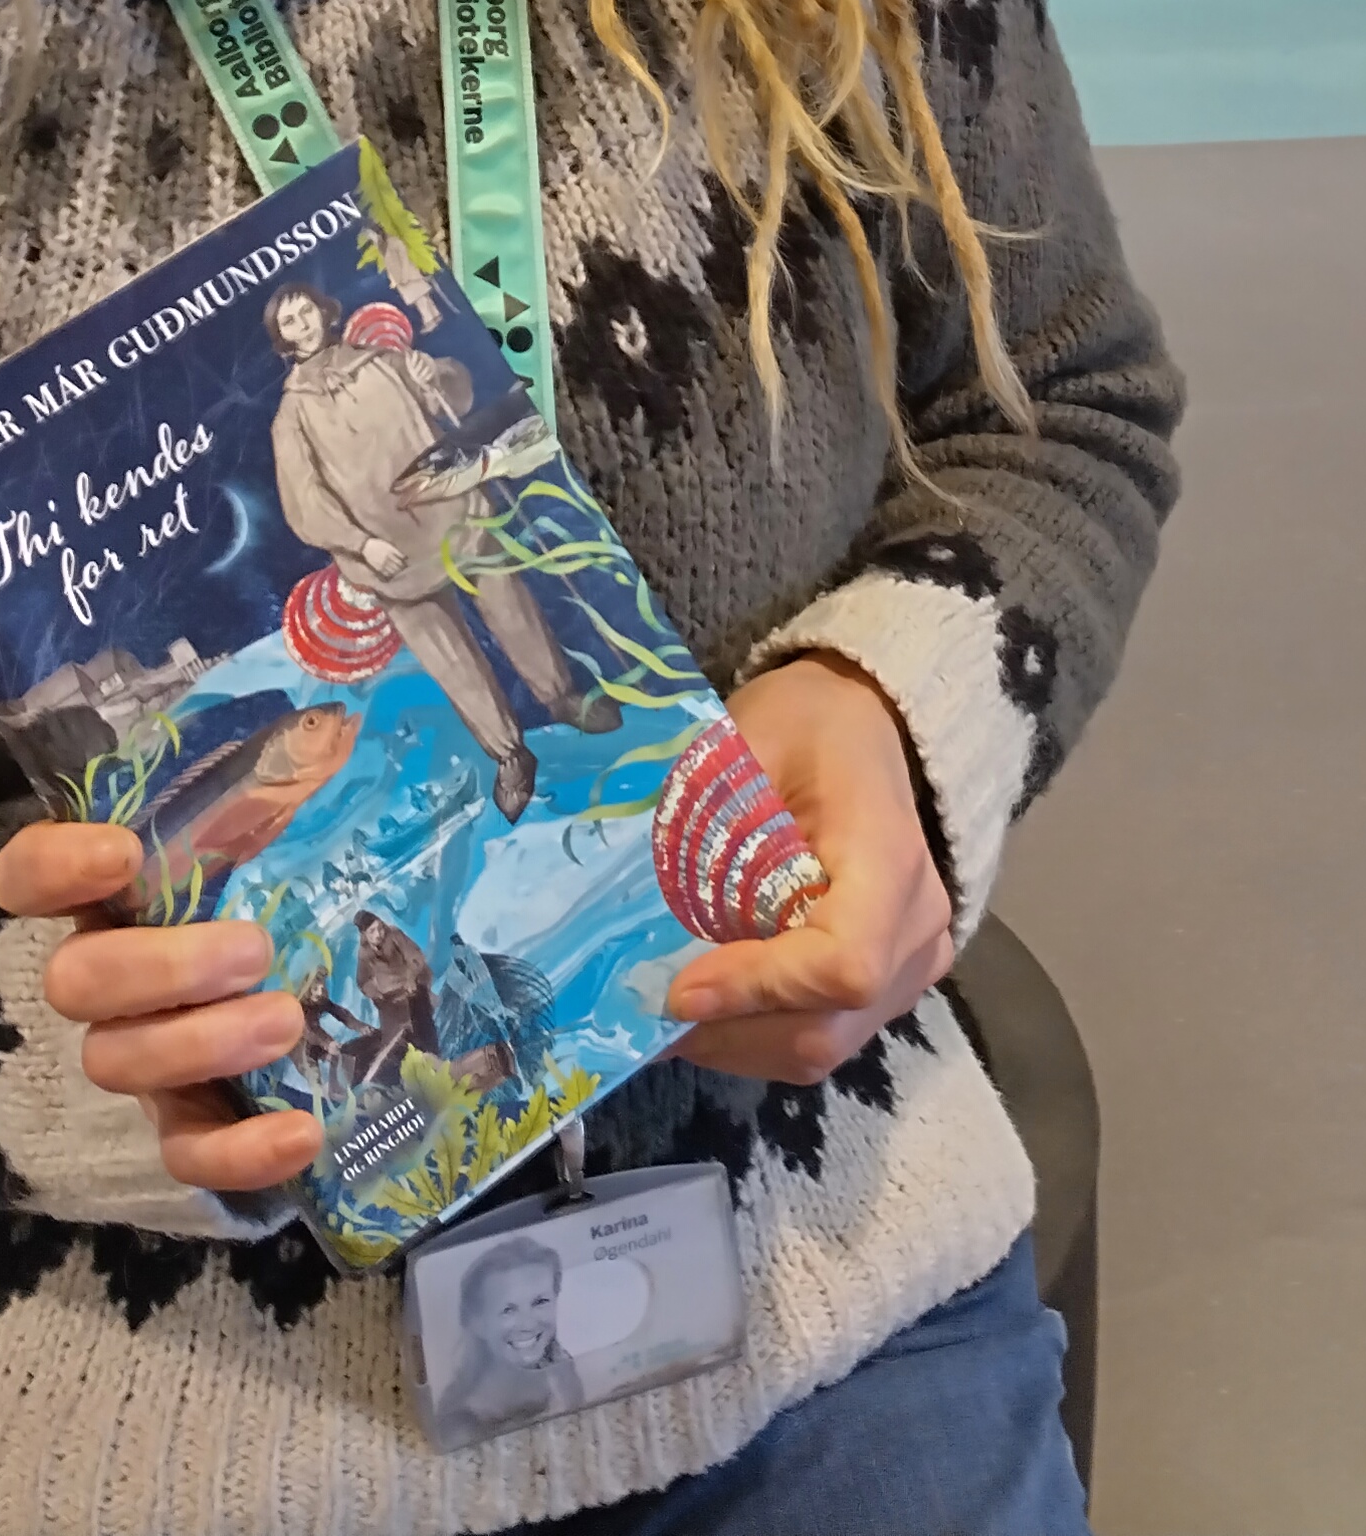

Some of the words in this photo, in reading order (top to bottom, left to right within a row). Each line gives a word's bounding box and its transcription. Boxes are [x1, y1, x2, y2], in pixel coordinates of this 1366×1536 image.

[22, 358, 107, 424] MÁR
[107, 192, 363, 370] GUÐMUNDSSON
[76, 422, 214, 526] kendes
[60, 548, 124, 626] for
[138, 482, 199, 557] ret
[333, 1096, 416, 1166] LINDHARDT
[342, 1159, 366, 1182] OG
[363, 1110, 427, 1166] RINGHOF
[589, 1213, 649, 1240] Karina
[593, 1225, 673, 1261] Øgendahl
